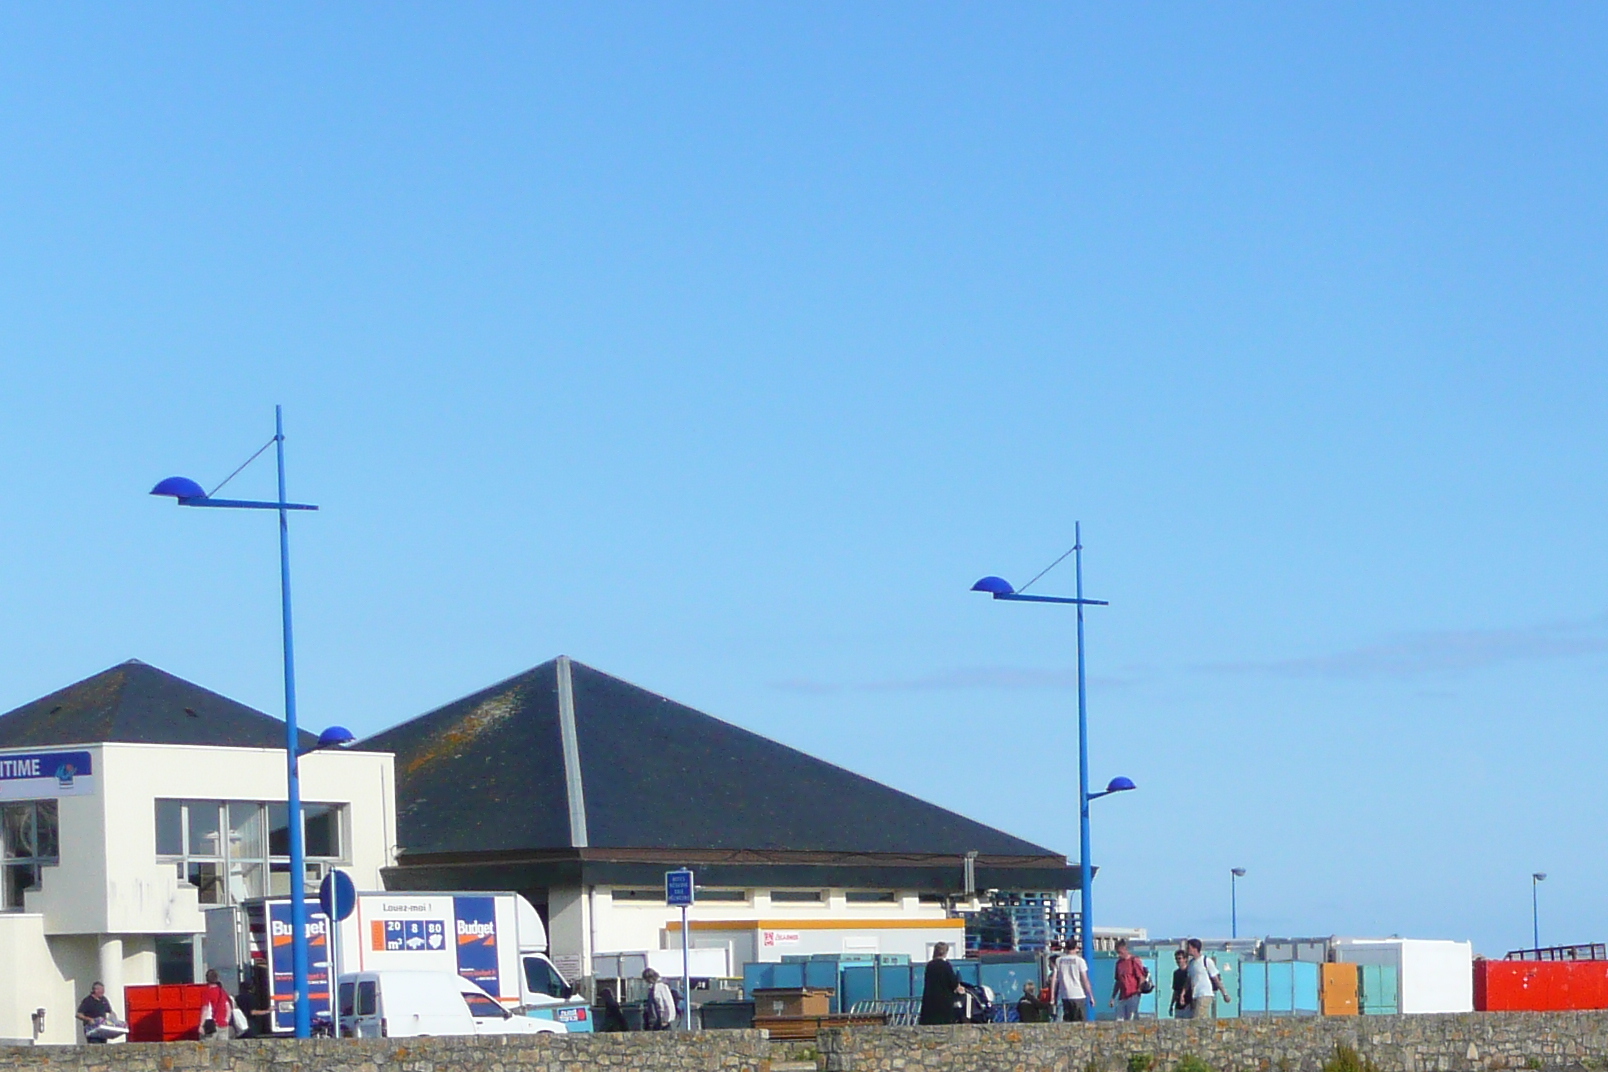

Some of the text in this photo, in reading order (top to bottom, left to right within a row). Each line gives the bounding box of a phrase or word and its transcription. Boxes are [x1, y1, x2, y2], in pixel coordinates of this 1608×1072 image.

[387, 921, 401, 931] 20
[411, 923, 418, 933] 8
[428, 923, 441, 933] 80
[457, 920, 495, 938] Budget
